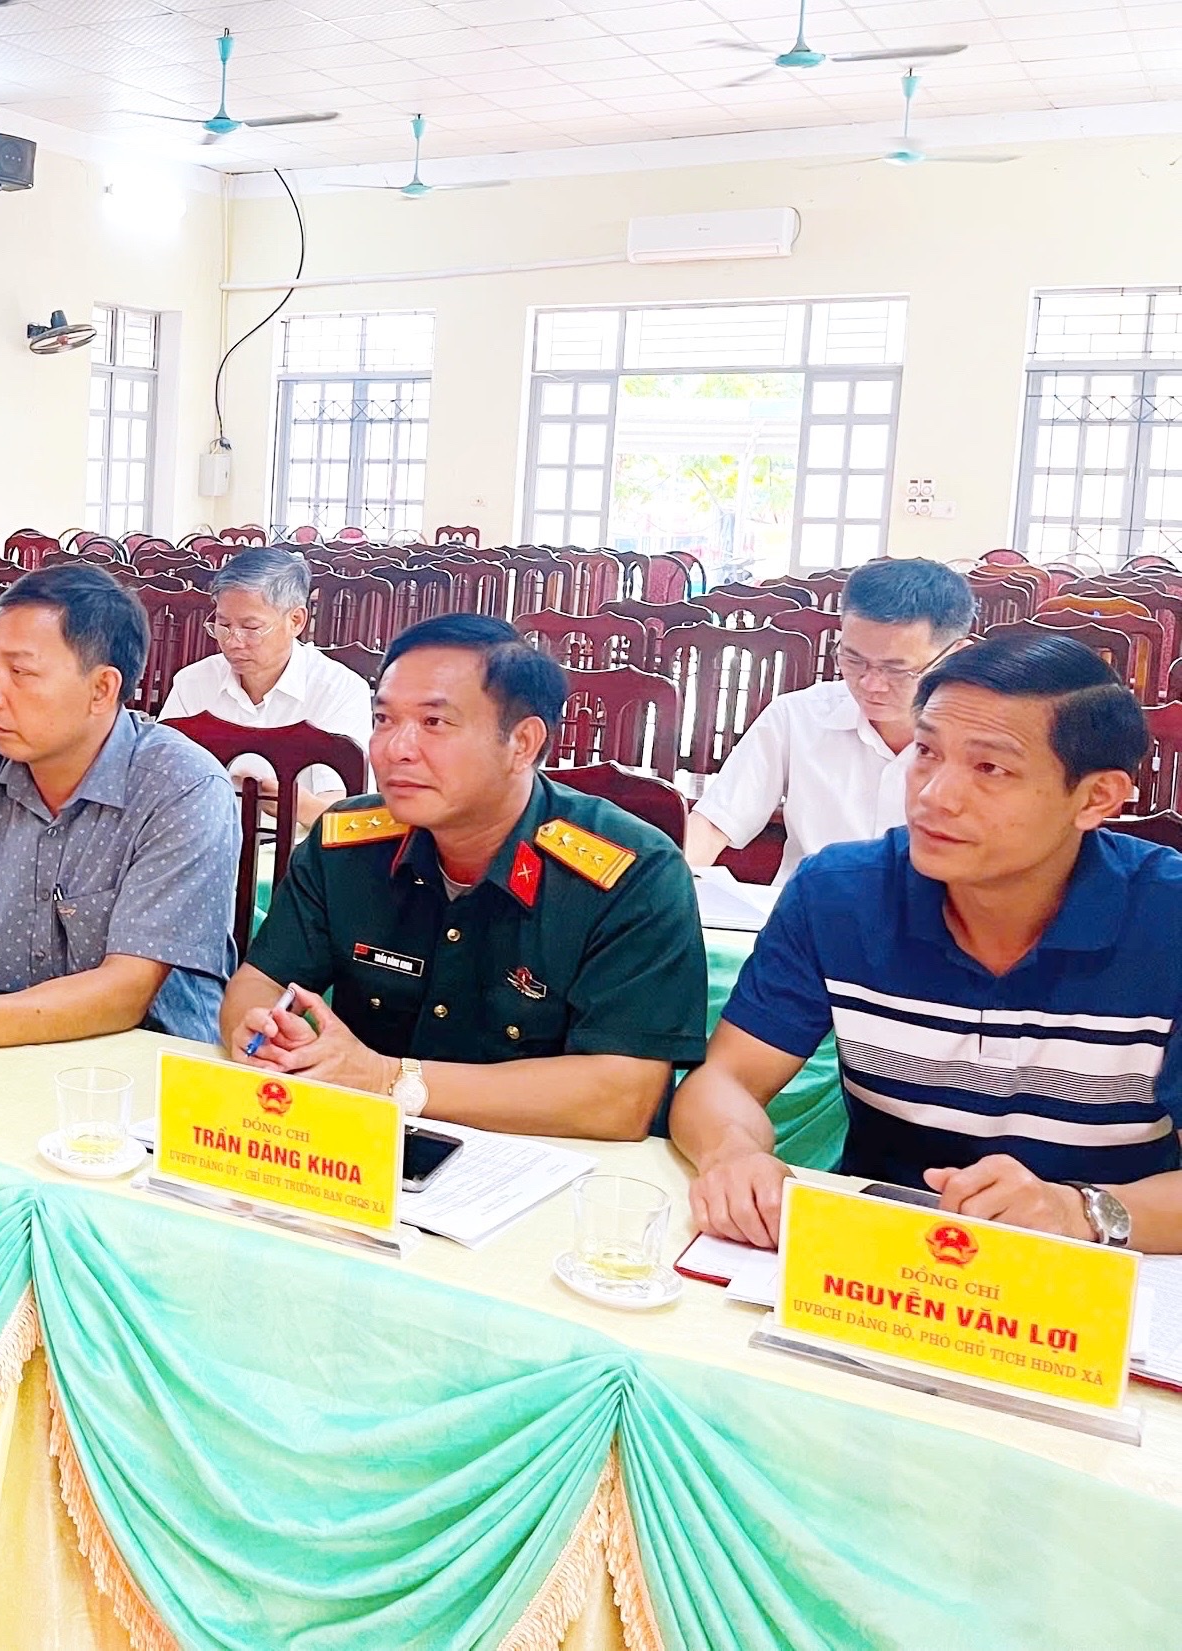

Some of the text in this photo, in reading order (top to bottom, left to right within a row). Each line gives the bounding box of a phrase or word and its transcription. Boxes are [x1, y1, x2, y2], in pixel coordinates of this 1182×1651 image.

[193, 1125, 362, 1185] TRẦN ĐĂNG KHOA
[242, 1117, 310, 1143] ĐỒNG CHÍ
[169, 1150, 197, 1165] UVBTV
[263, 1172, 282, 1187] HUY
[323, 1187, 343, 1202] BAN
[345, 1194, 370, 1210] CHQS
[900, 1264, 1001, 1301] ĐỒNG CHÍ
[793, 1299, 841, 1322] UVBCH
[845, 1308, 888, 1334] ĐẢNG
[920, 1329, 951, 1350] PHÓ
[954, 1336, 985, 1358] CHỦ
[990, 1346, 1026, 1369] TỊCH
[1030, 1355, 1076, 1379] HĐND
[1081, 1367, 1104, 1387] XÃ
[823, 1274, 1079, 1354] NGUYỄN VĂN LỢI
